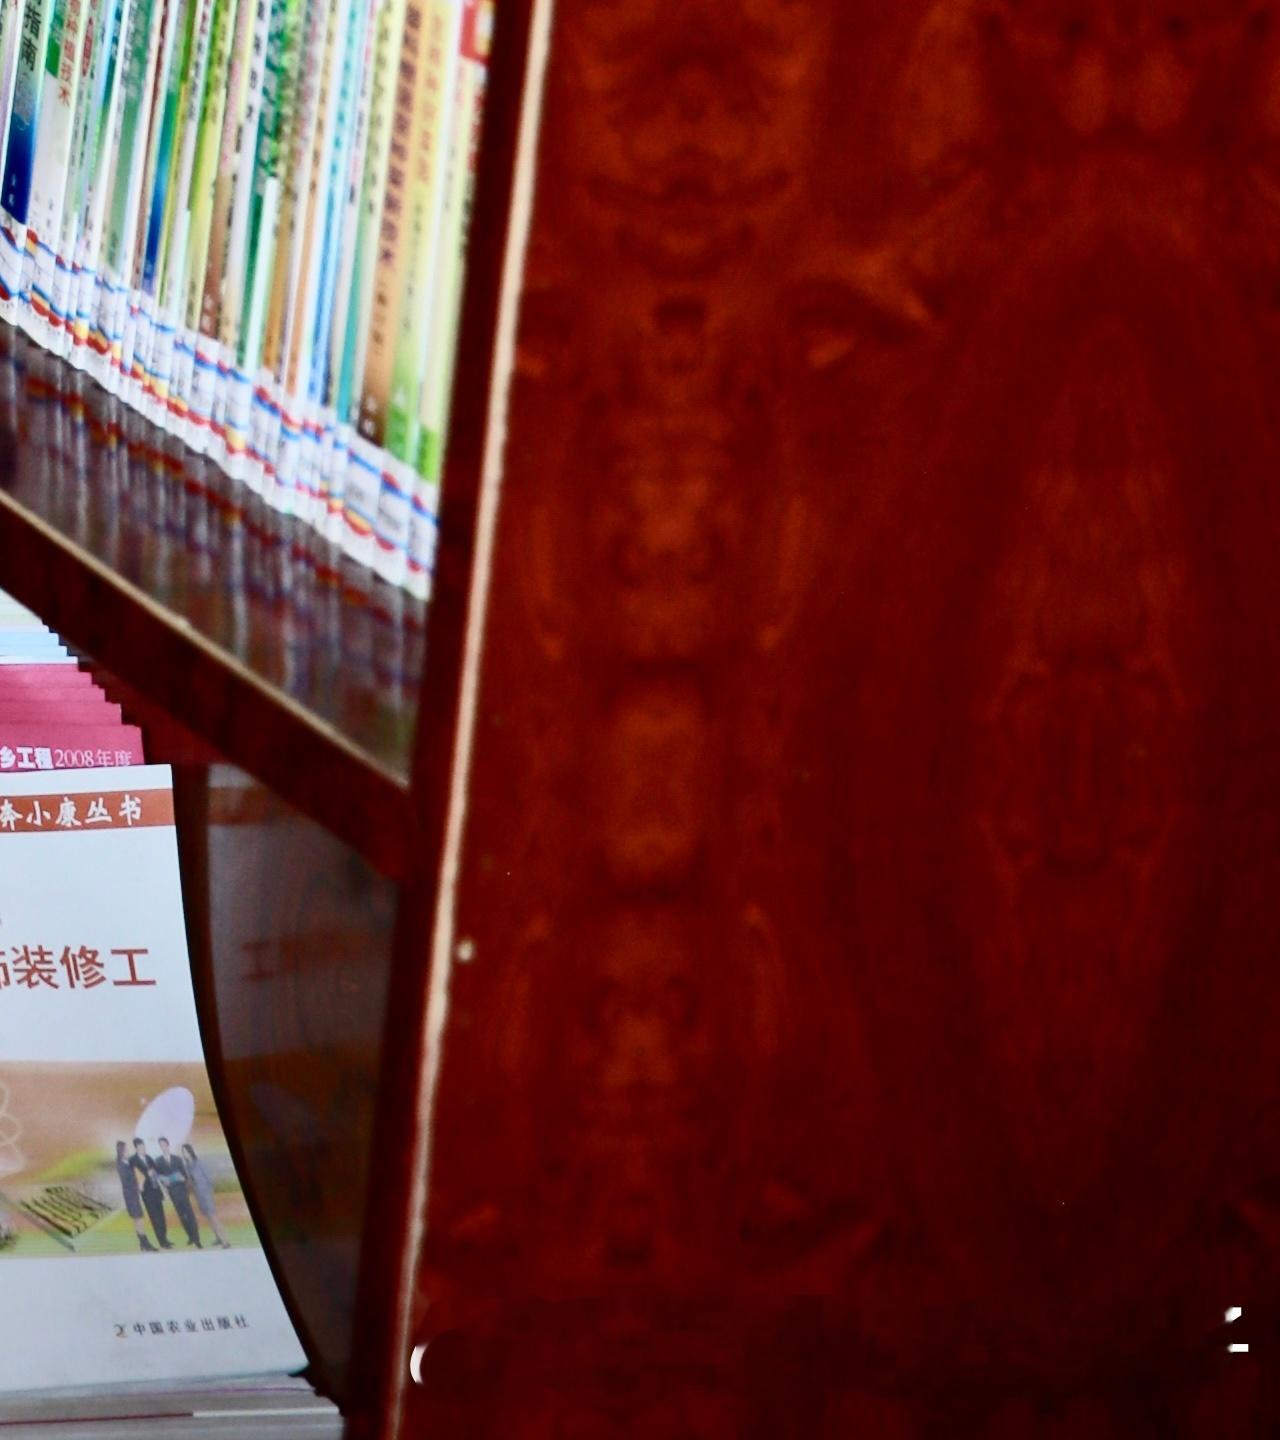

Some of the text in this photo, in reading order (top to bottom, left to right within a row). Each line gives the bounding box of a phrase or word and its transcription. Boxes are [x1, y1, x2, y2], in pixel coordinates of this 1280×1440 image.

[53, 747, 133, 768] 2008年度
[132, 1314, 250, 1336] 中国农业出版社
